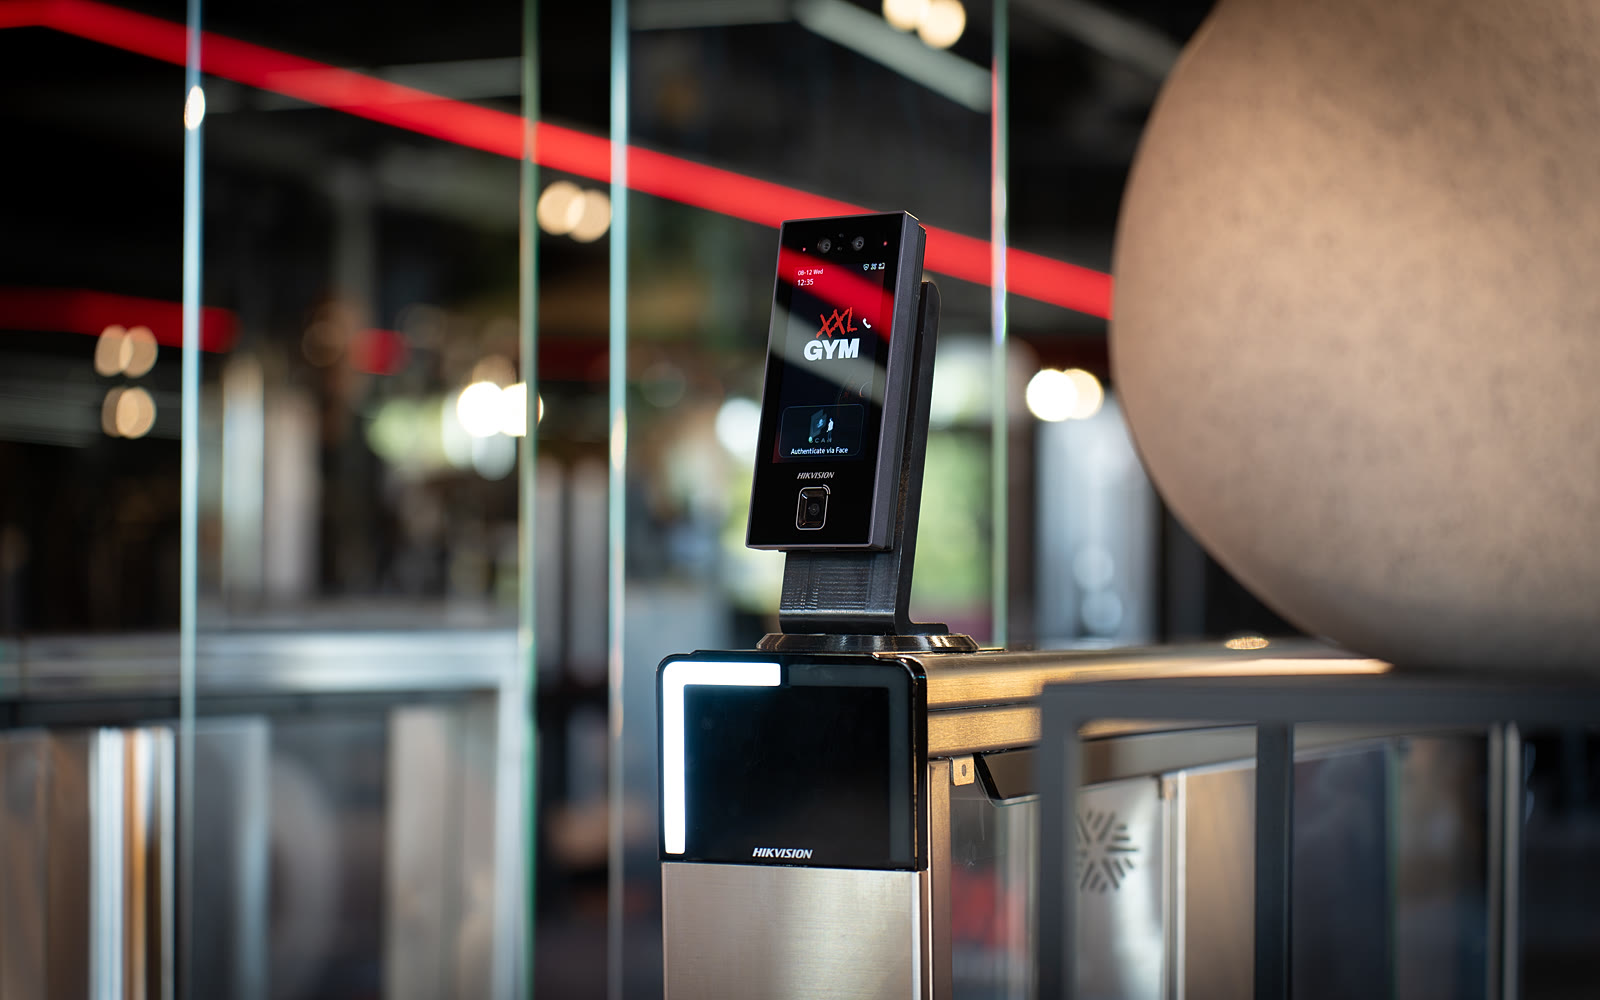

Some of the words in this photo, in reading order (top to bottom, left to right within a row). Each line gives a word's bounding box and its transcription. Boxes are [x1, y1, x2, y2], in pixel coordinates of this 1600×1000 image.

[797, 278, 814, 286] 12:35
[816, 307, 858, 338] XXL
[804, 338, 860, 361] GYM
[752, 847, 813, 859] HIKVISION
